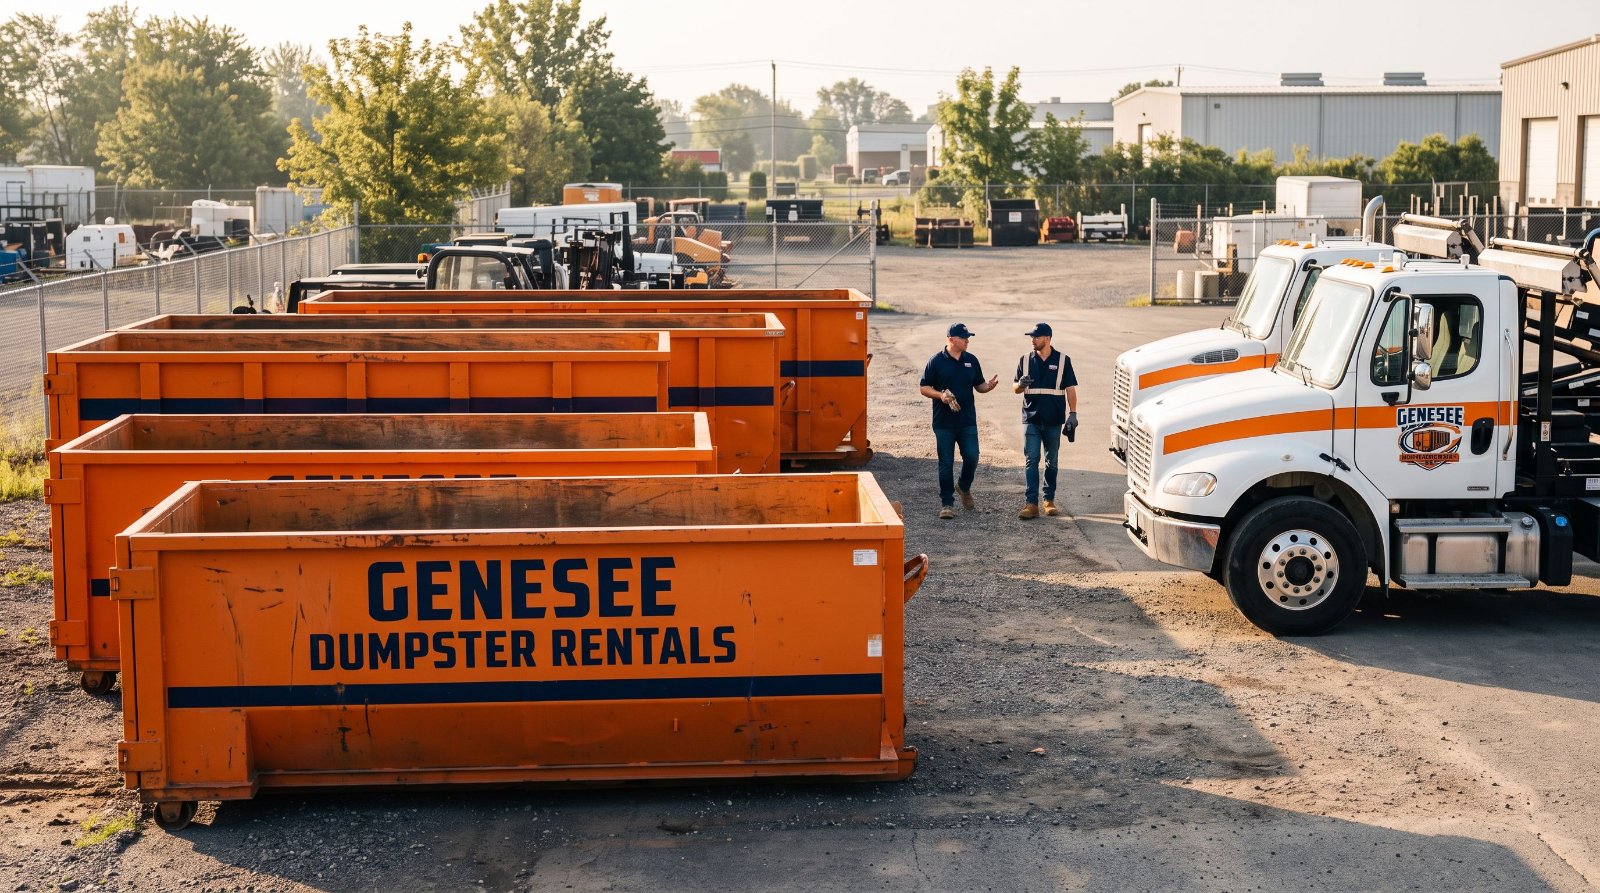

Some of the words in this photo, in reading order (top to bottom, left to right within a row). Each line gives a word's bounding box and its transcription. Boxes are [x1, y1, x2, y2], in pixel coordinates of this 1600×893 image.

[1397, 407, 1463, 426] GENESEE
[367, 556, 677, 622] GENESEE
[309, 629, 537, 671] DUMPSTER
[551, 625, 736, 666] RENTALS
